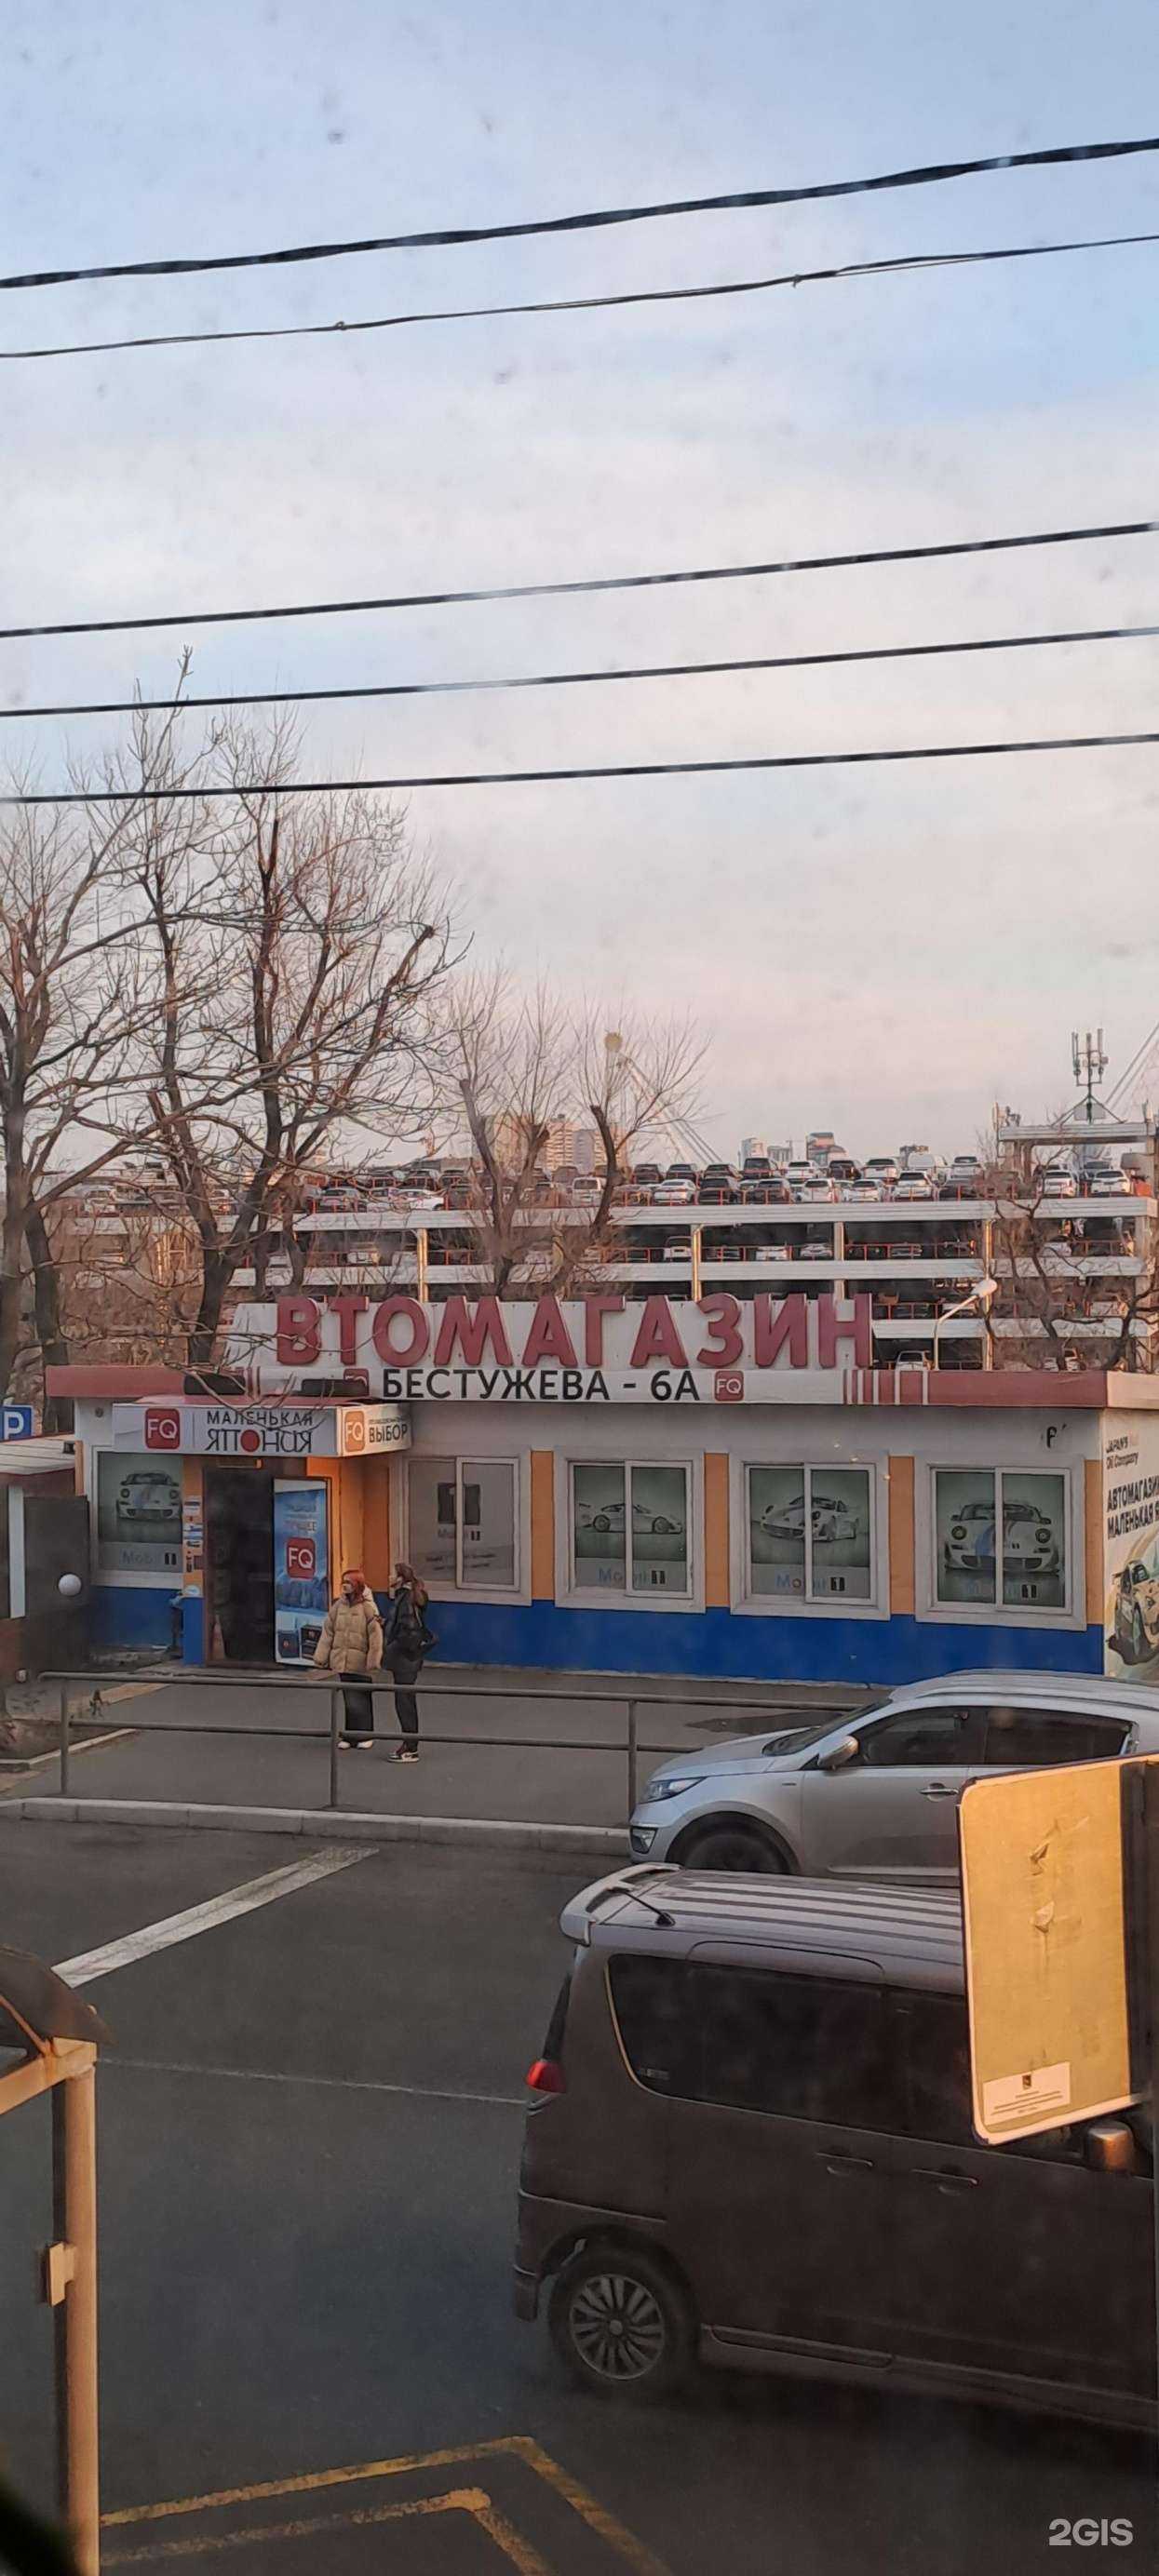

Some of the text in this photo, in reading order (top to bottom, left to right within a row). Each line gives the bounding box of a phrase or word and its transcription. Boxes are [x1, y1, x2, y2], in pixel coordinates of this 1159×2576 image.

[275, 1293, 875, 1368] ВТОМАГАЗИН
[383, 1370, 610, 1401] БЕСТУЖЕВА
[650, 1370, 700, 1401] 6А
[717, 1379, 742, 1395] FQ
[4, 1412, 25, 1441] P
[207, 1410, 314, 1425] МАЛЕНЬКАЯ
[148, 1418, 177, 1440] FQ
[346, 1421, 364, 1442] FQ
[369, 1424, 408, 1444] ВЫБОР
[289, 1548, 313, 1569] FQ
